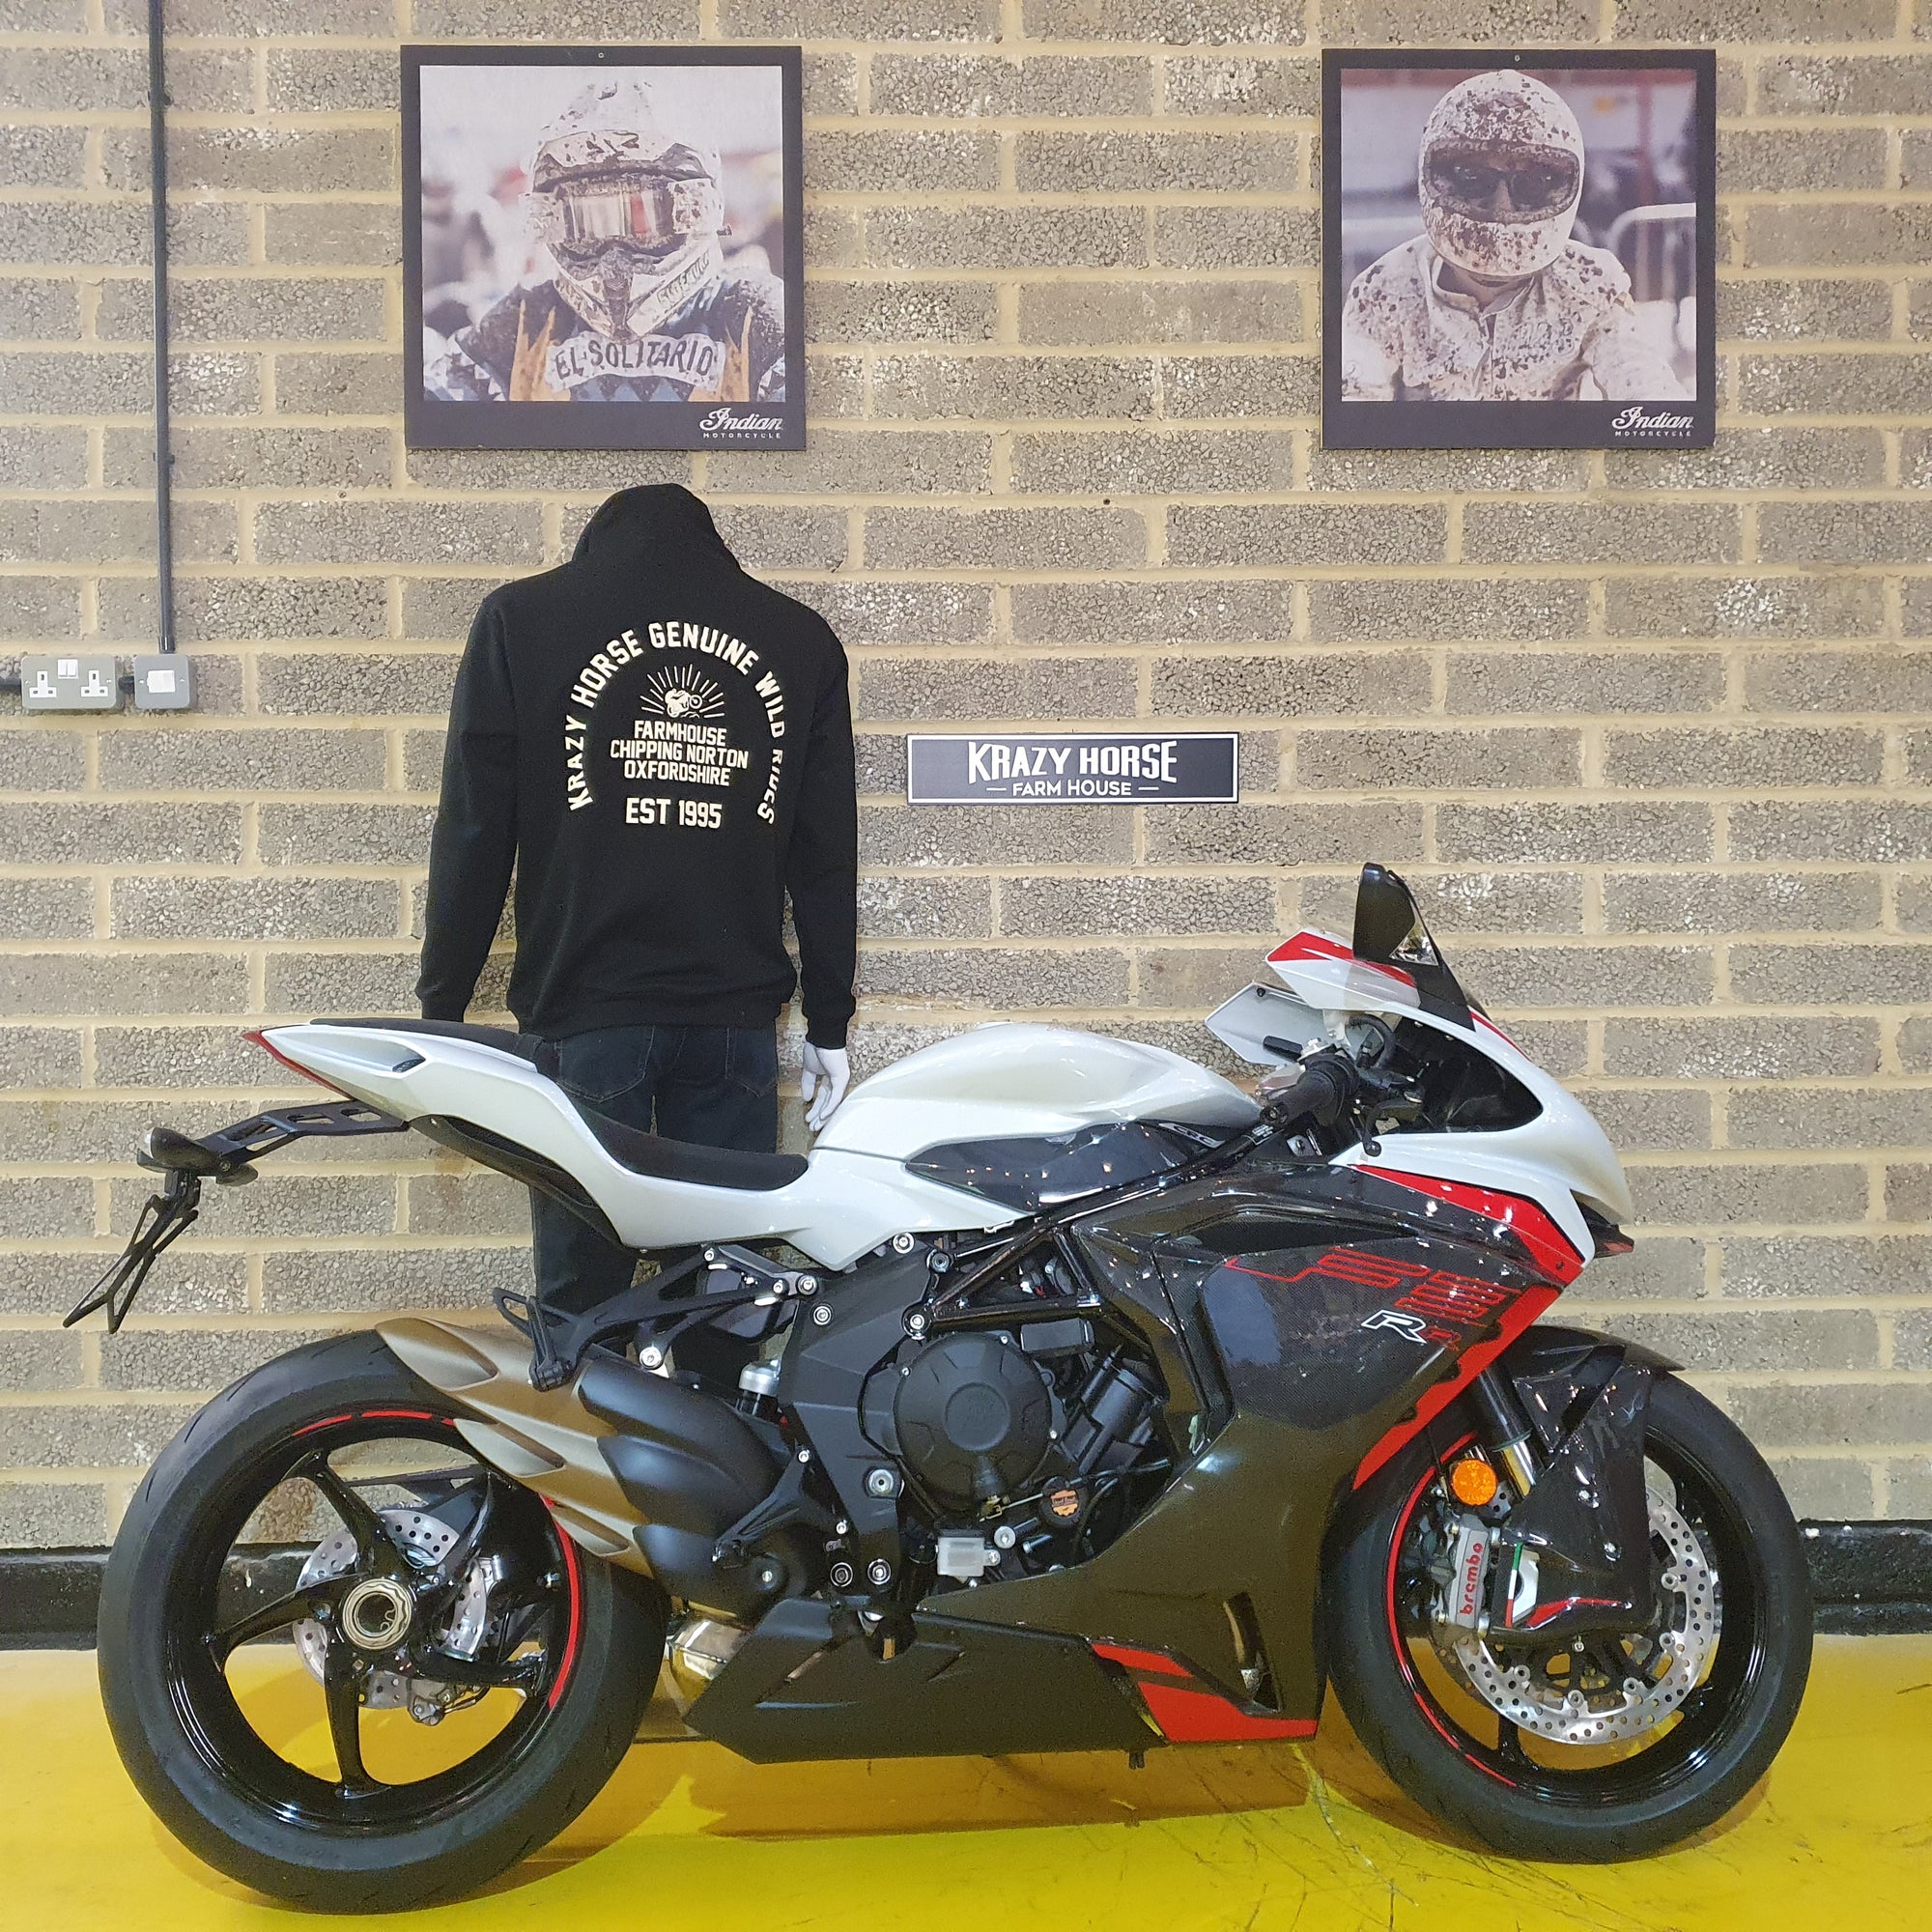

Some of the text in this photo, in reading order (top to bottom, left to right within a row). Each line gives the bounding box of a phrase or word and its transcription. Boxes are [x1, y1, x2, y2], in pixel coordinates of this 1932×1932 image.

[554, 338, 714, 380] EL SOLITARIO
[698, 407, 783, 432] Indian
[1611, 406, 1694, 430] Indian
[647, 621, 759, 675] GENUINE
[570, 629, 644, 709] HORSE
[754, 670, 785, 738] WILD
[634, 720, 727, 748] FARMHOUSE
[565, 715, 594, 811] KRAZY
[610, 739, 749, 770] CHIPPING NORTON
[624, 759, 730, 787] OXFORDSHIRE
[968, 740, 1178, 784] KRAZY HORSE
[1012, 779, 1132, 796] FARM HOUSE
[625, 797, 723, 829] EST 1995
[1459, 1543, 1484, 1615] brembo
